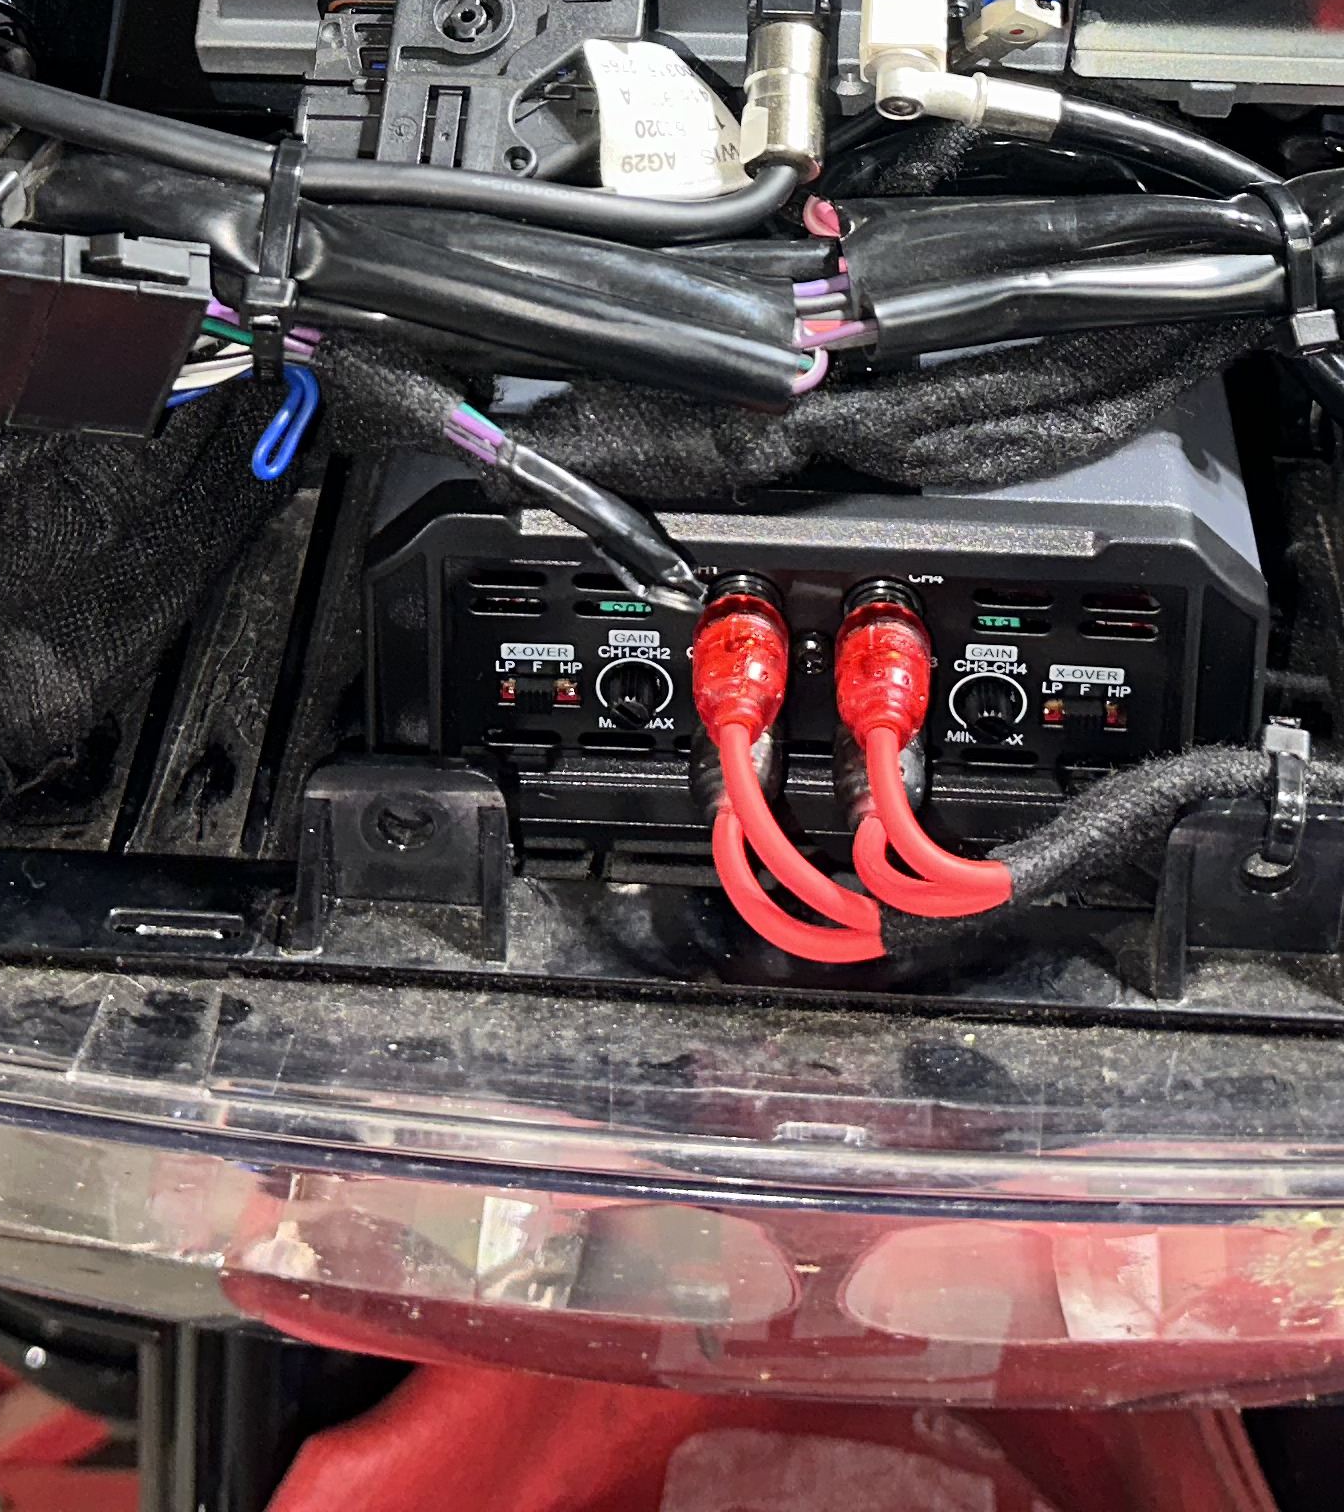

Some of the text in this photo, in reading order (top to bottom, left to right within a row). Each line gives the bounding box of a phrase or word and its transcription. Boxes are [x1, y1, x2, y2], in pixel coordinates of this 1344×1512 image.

[620, 151, 676, 174] AG29
[614, 632, 656, 644] GAIN
[506, 645, 570, 659] X-OVER
[597, 645, 672, 660] CH1-CH2
[970, 647, 1013, 659] GAIN
[495, 660, 584, 674] LP F HP
[953, 659, 1028, 676] CH3-CH4
[1055, 667, 1119, 681] X-OVER
[1041, 681, 1132, 699] LP F HP
